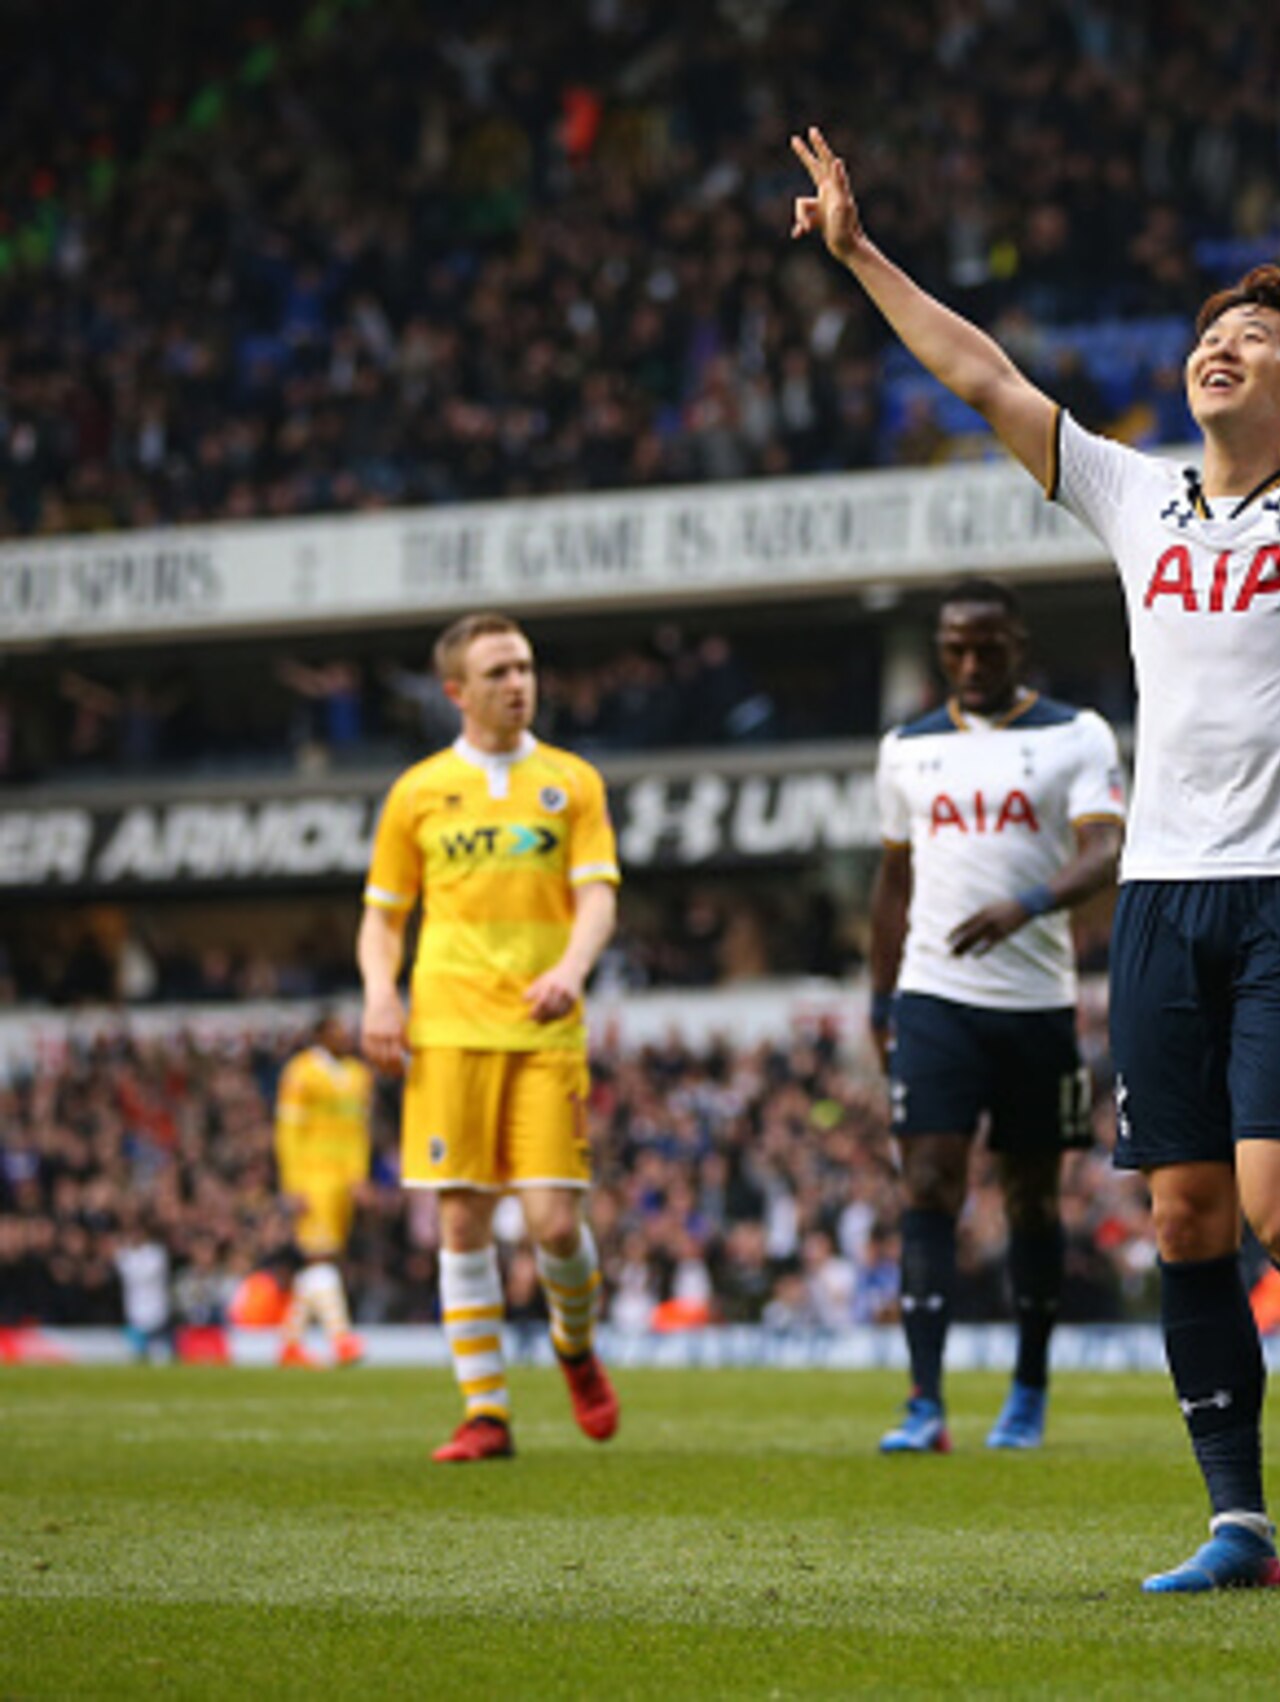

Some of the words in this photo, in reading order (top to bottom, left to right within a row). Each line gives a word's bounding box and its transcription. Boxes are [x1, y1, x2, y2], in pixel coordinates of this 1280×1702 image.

[402, 520, 484, 586] THE
[504, 511, 646, 578] GAME
[664, 505, 720, 568] IS
[741, 495, 908, 562] ABOUT
[68, 549, 222, 608] SPURS
[929, 790, 1040, 835] AIA
[441, 826, 499, 859] WT
